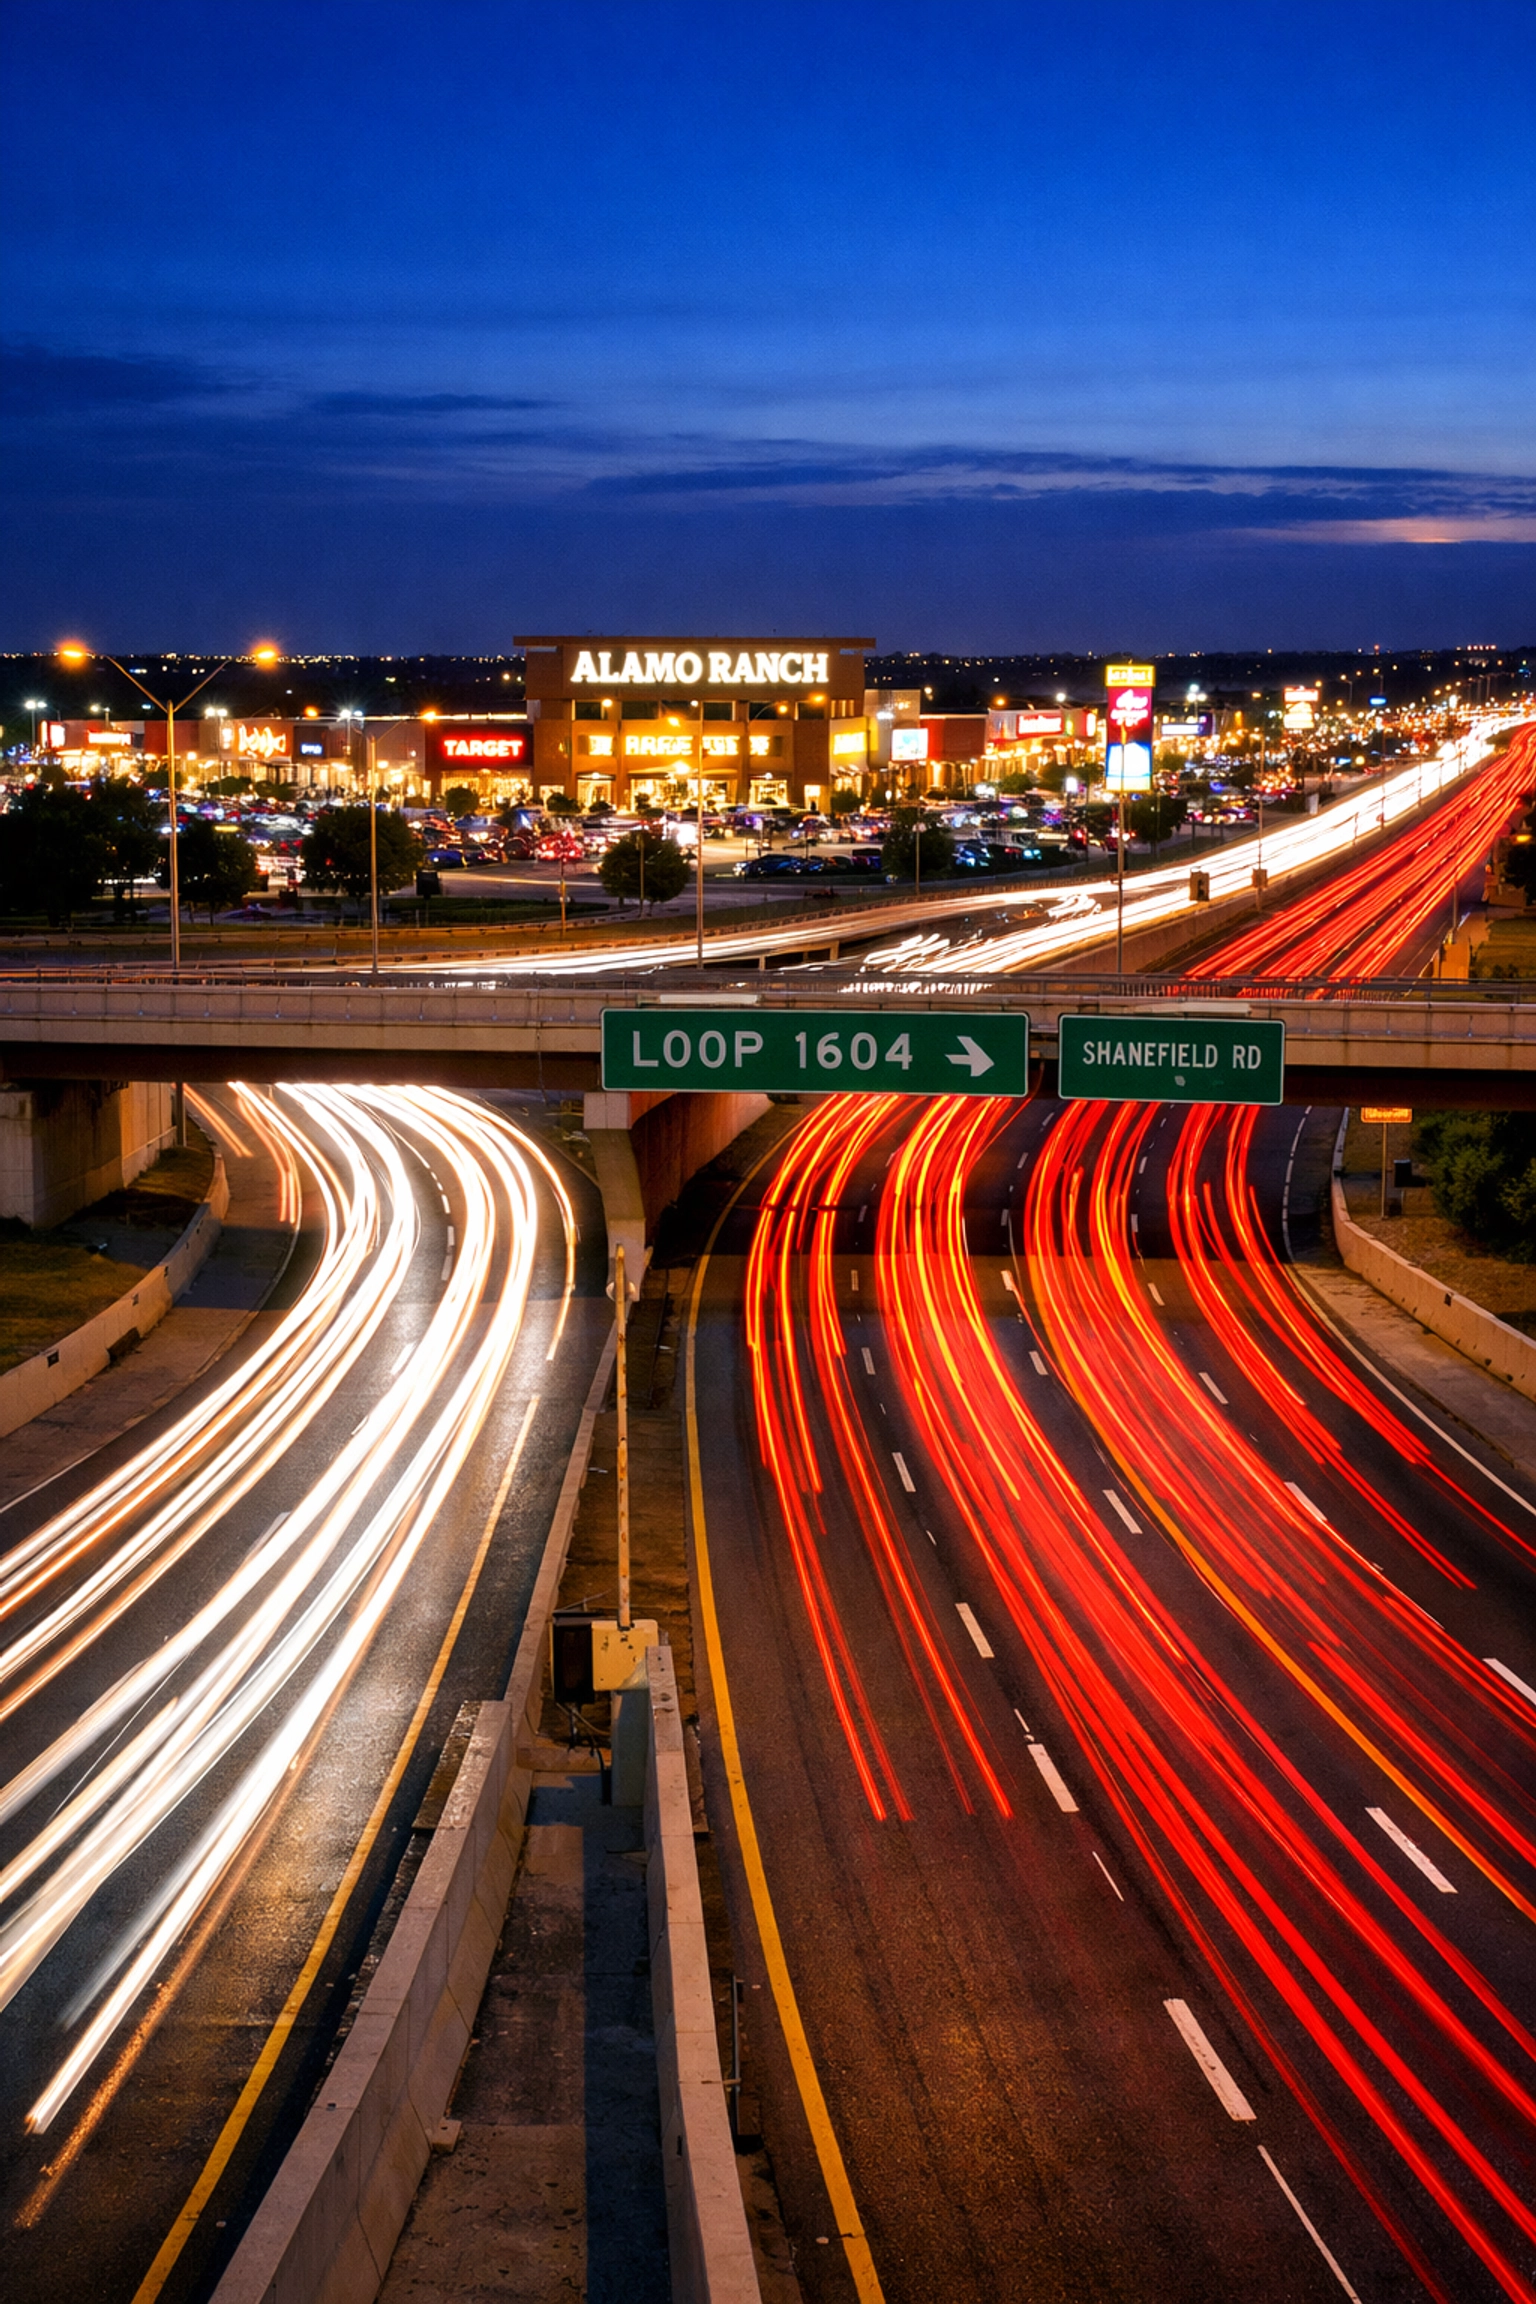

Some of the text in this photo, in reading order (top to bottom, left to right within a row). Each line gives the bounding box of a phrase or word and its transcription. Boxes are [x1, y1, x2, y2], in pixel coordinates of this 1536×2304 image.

[571, 650, 830, 685] ALAMO RANCH
[444, 739, 524, 757] TARGET
[631, 1030, 914, 1071] LOOP 1604
[1082, 1041, 1262, 1070] SHANEFIELD RD
